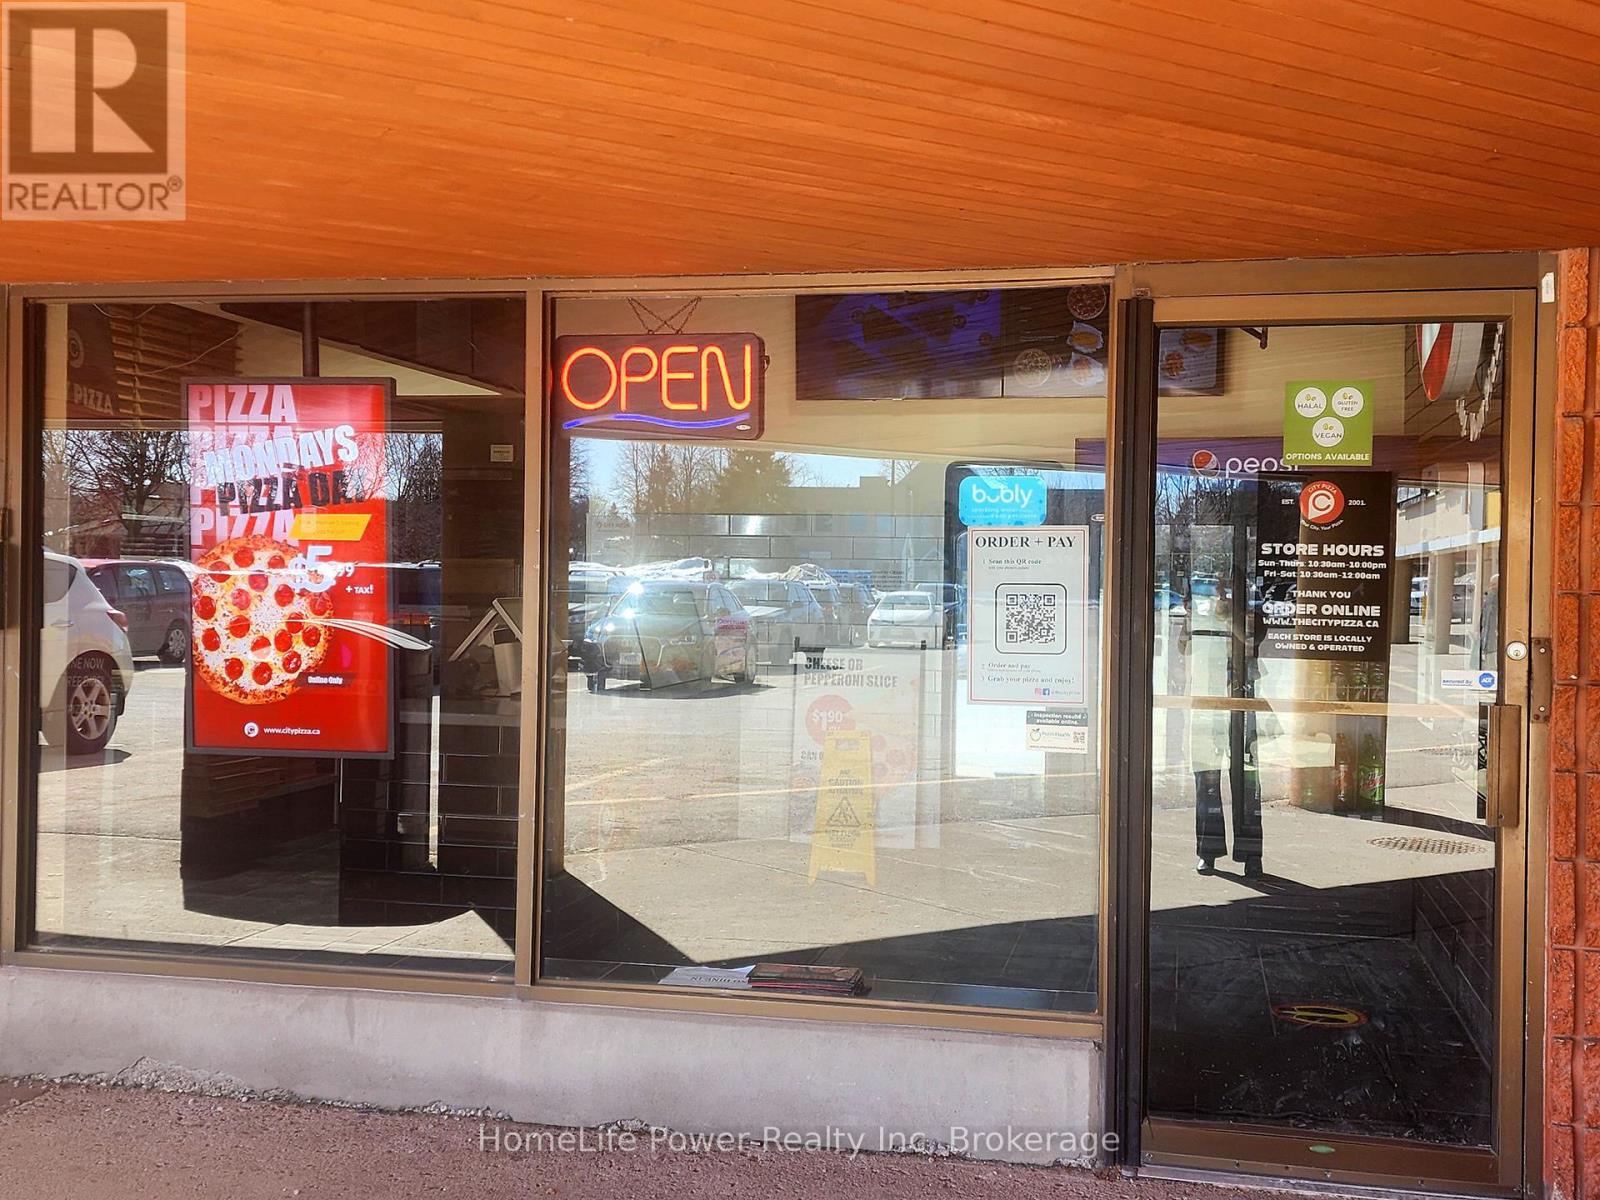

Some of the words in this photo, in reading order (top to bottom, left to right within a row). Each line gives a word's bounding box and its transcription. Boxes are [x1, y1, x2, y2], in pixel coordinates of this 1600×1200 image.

[560, 343, 752, 412] OPEN
[72, 382, 114, 416] PIZZA
[188, 384, 298, 423] PIZZA
[205, 425, 358, 487] MONDAYS
[1285, 452, 1323, 461] OPTIONS
[1324, 452, 1371, 462] AVAILABLE
[217, 470, 303, 516] PIZZA
[1307, 483, 1321, 493] CITY
[1321, 483, 1337, 495] PIZZA
[971, 483, 1033, 509] bubly
[975, 535, 1031, 548] ORDER
[1034, 537, 1044, 547] +
[1047, 535, 1077, 548] PAY
[1261, 542, 1319, 556] STORE
[1322, 543, 1385, 557] HOURS
[988, 558, 1003, 566] Scan
[1005, 558, 1015, 566] this
[1016, 558, 1027, 566] QR
[1028, 558, 1042, 566] code
[353, 584, 375, 594] TAX!
[1292, 590, 1328, 598] THANK
[1329, 590, 1351, 599] YOU
[1262, 602, 1318, 616] ORDER
[1320, 604, 1381, 617] ONLINE
[1262, 617, 1379, 628] WWW.THECITYPIZZA.CA
[1267, 633, 1291, 641] EACH
[1292, 634, 1322, 642] STORE
[1323, 634, 1332, 642] IS
[1334, 635, 1373, 643] LOCALLY
[1275, 642, 1308, 650] OWNED
[1308, 643, 1316, 651] &
[1317, 643, 1365, 652] OPERATED
[804, 657, 846, 671] CHEESE
[848, 658, 864, 671] OR
[307, 675, 328, 685] Online
[328, 675, 343, 686] Only
[804, 673, 865, 687] PEPPERONI
[866, 675, 898, 688] SLICE
[1022, 676, 1040, 684] pizza
[1033, 713, 1063, 721] Inspection
[263, 726, 321, 736] www.citypizza.ca
